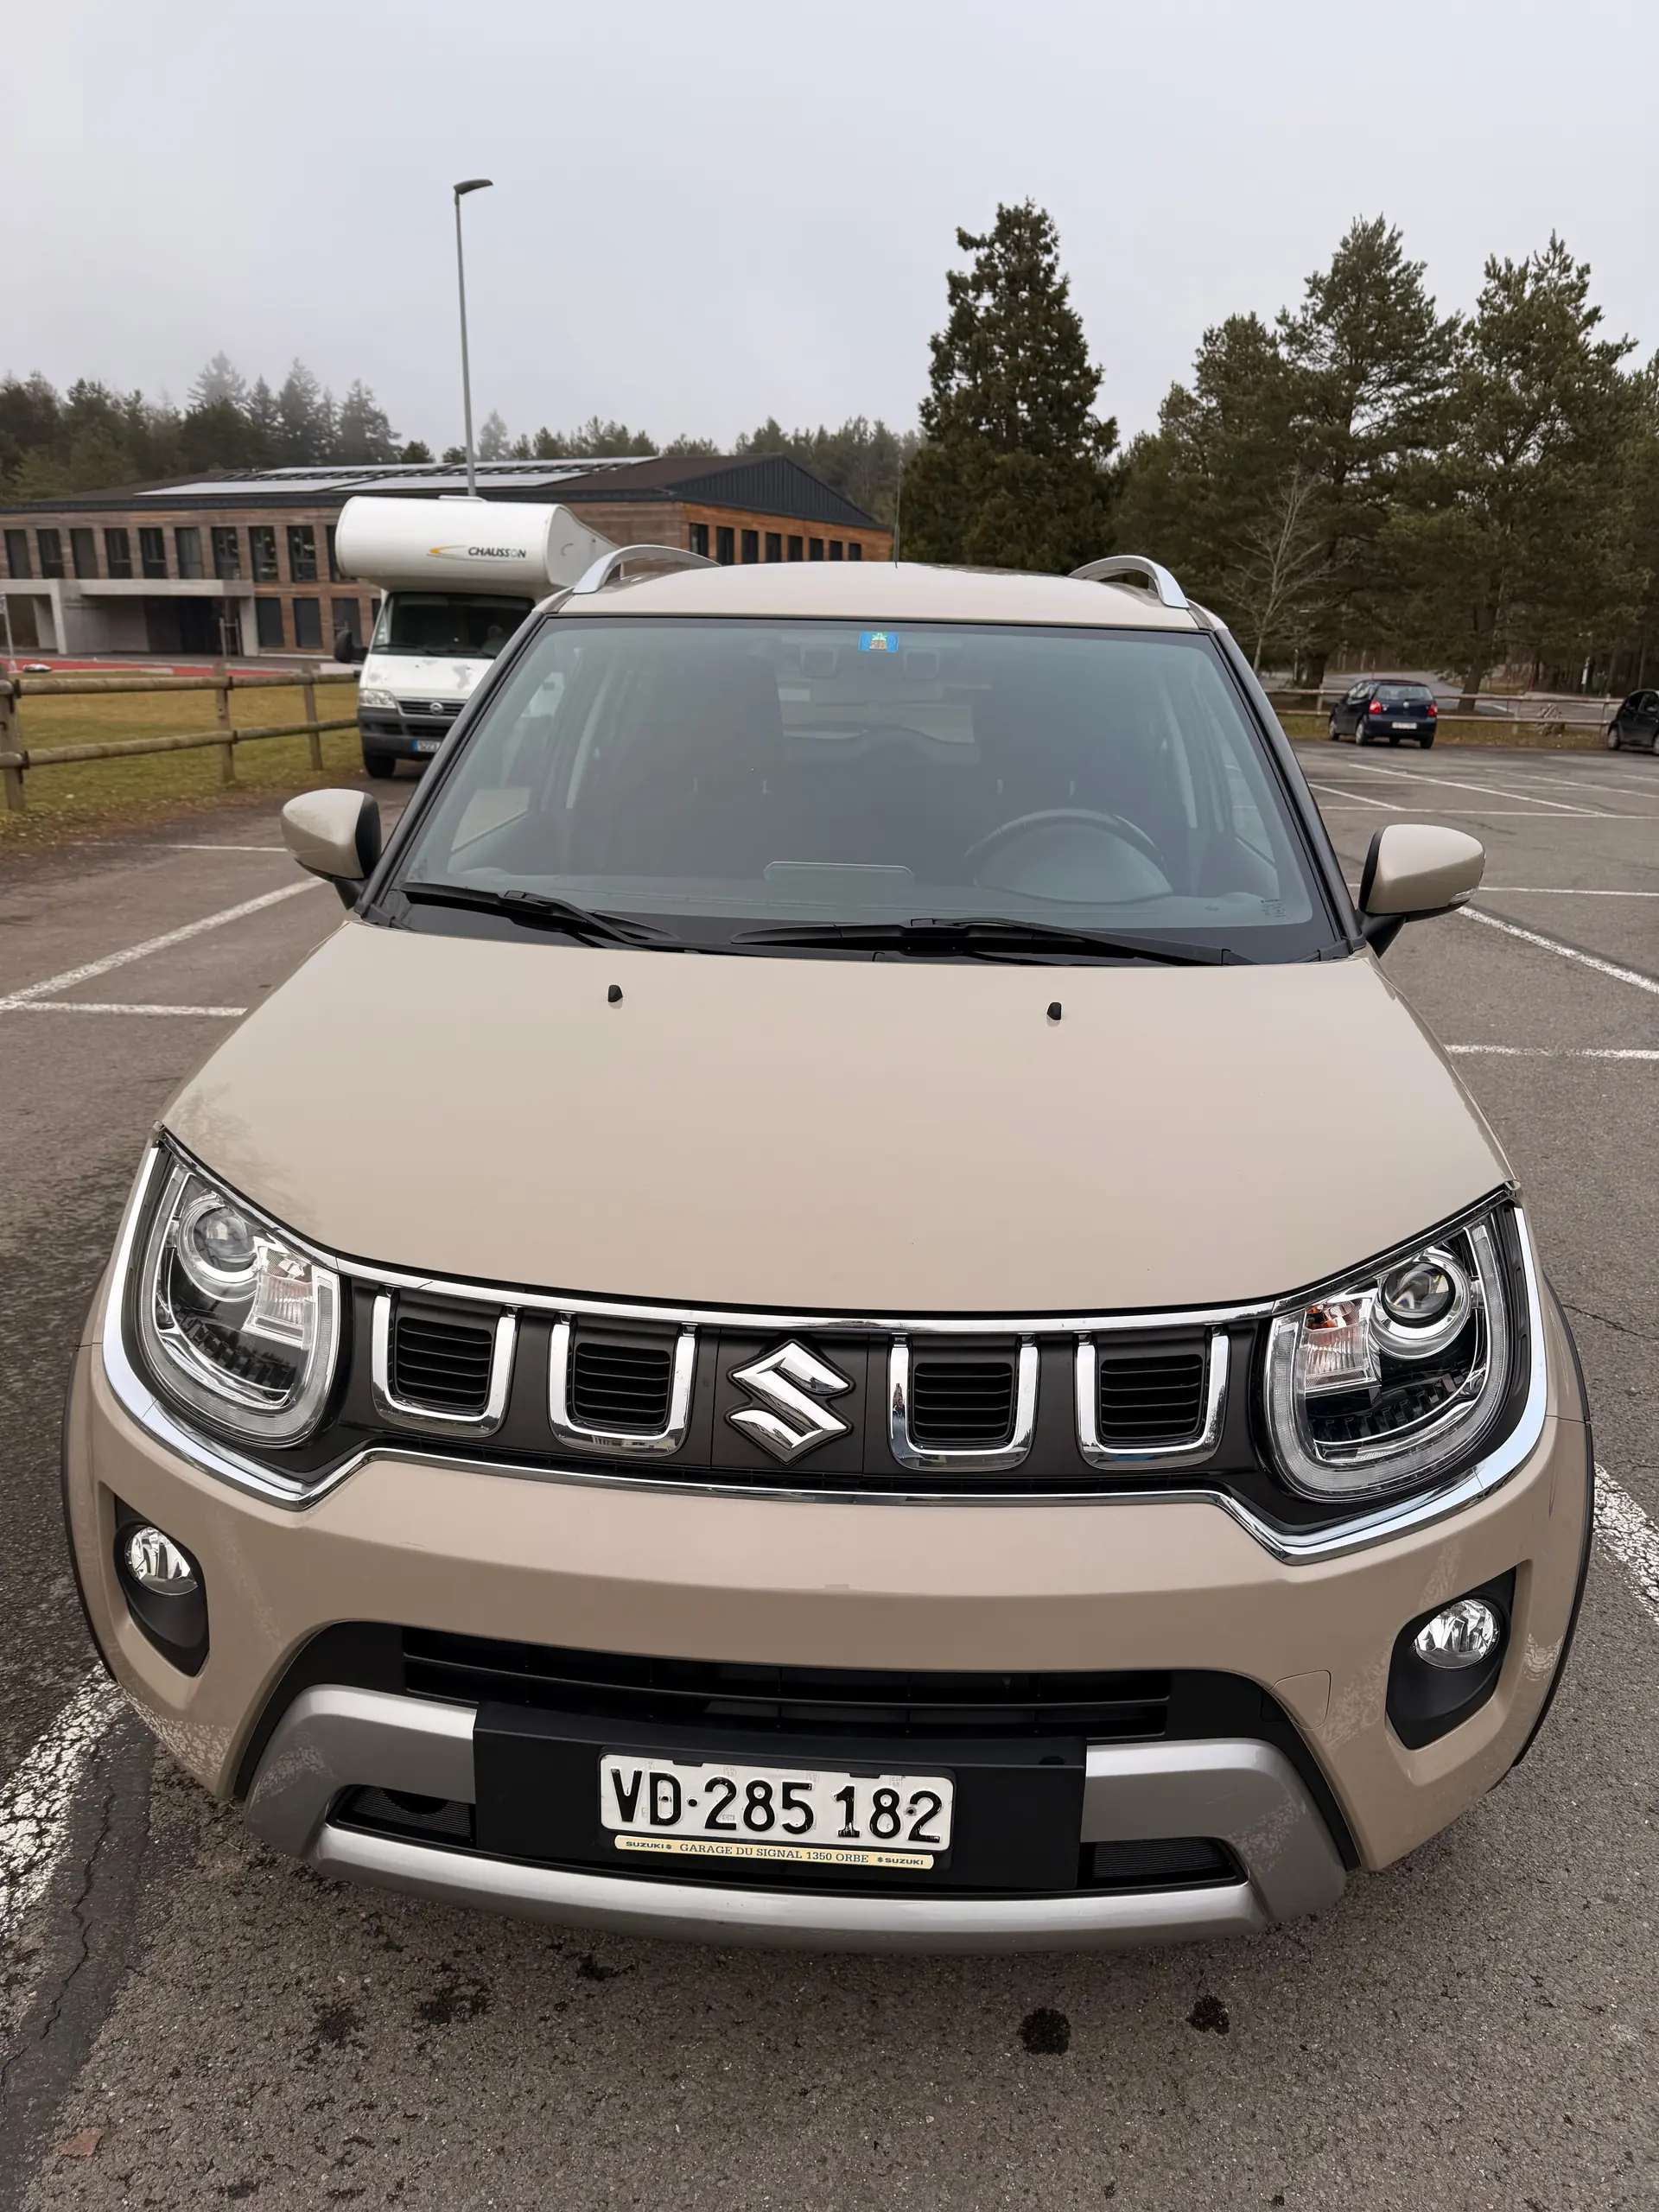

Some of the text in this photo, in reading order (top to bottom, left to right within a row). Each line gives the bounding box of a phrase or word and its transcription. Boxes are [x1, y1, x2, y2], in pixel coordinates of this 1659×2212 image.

[467, 546, 526, 558] CHAUSSON
[626, 1840, 924, 1866] SUZUKI GARAGE DU SIGNAL 1350 ORBE SUZUKI
